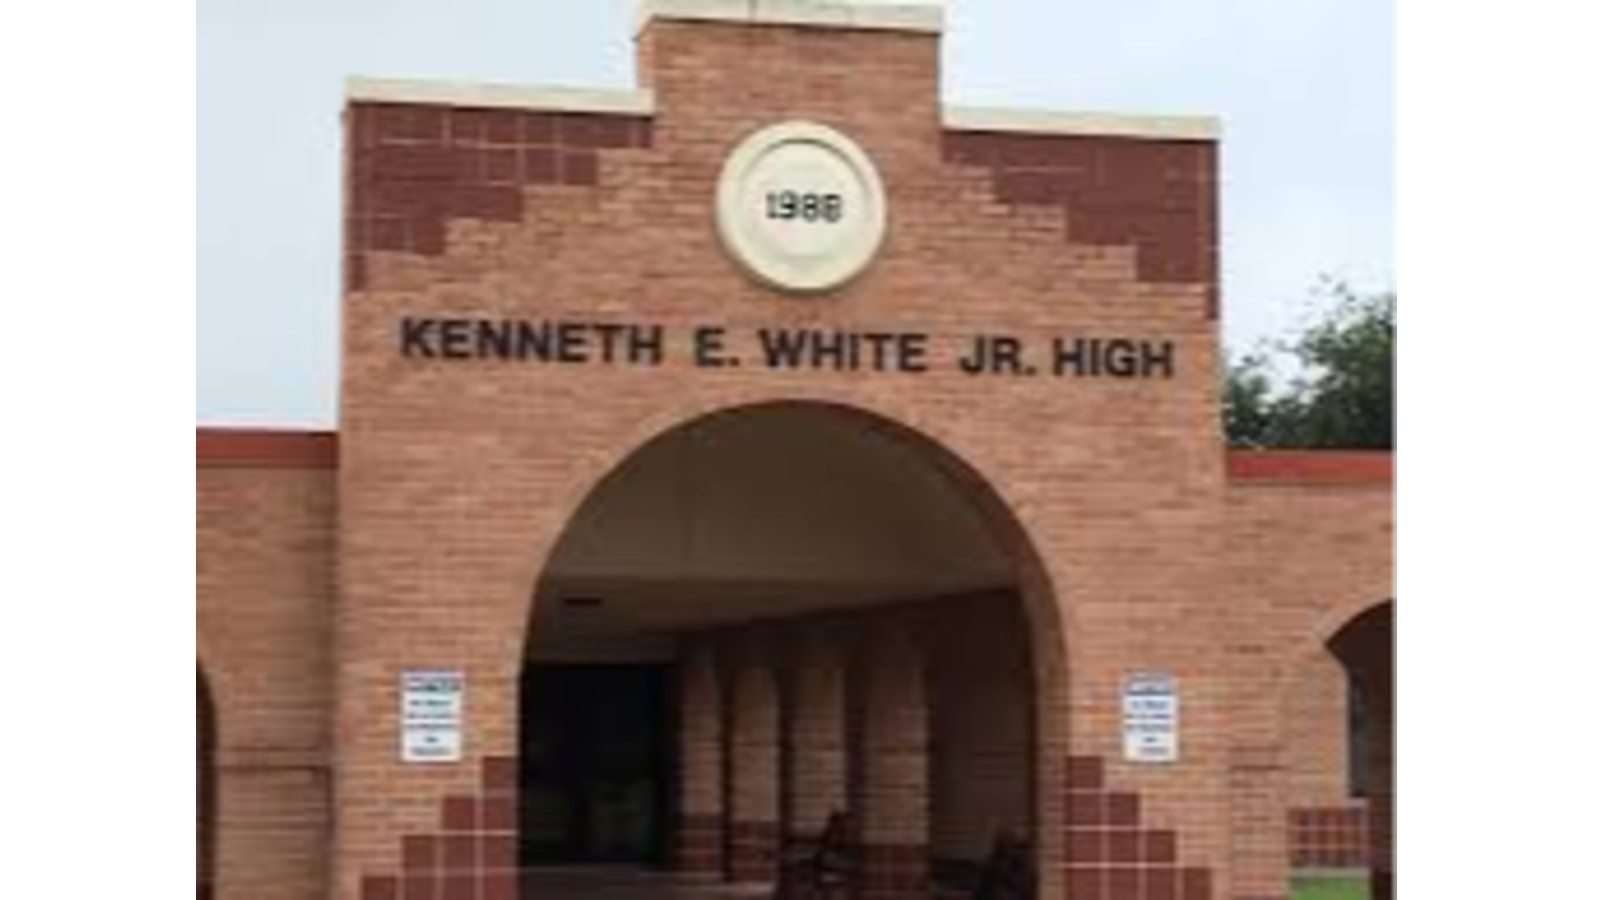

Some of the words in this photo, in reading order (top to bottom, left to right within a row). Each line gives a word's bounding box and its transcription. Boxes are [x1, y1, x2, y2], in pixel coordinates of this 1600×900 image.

[401, 317, 664, 365] KENNETH
[694, 328, 740, 368] E.
[757, 328, 929, 372] WHITE
[959, 335, 1037, 376] JR.
[1053, 337, 1175, 378] HIGH
